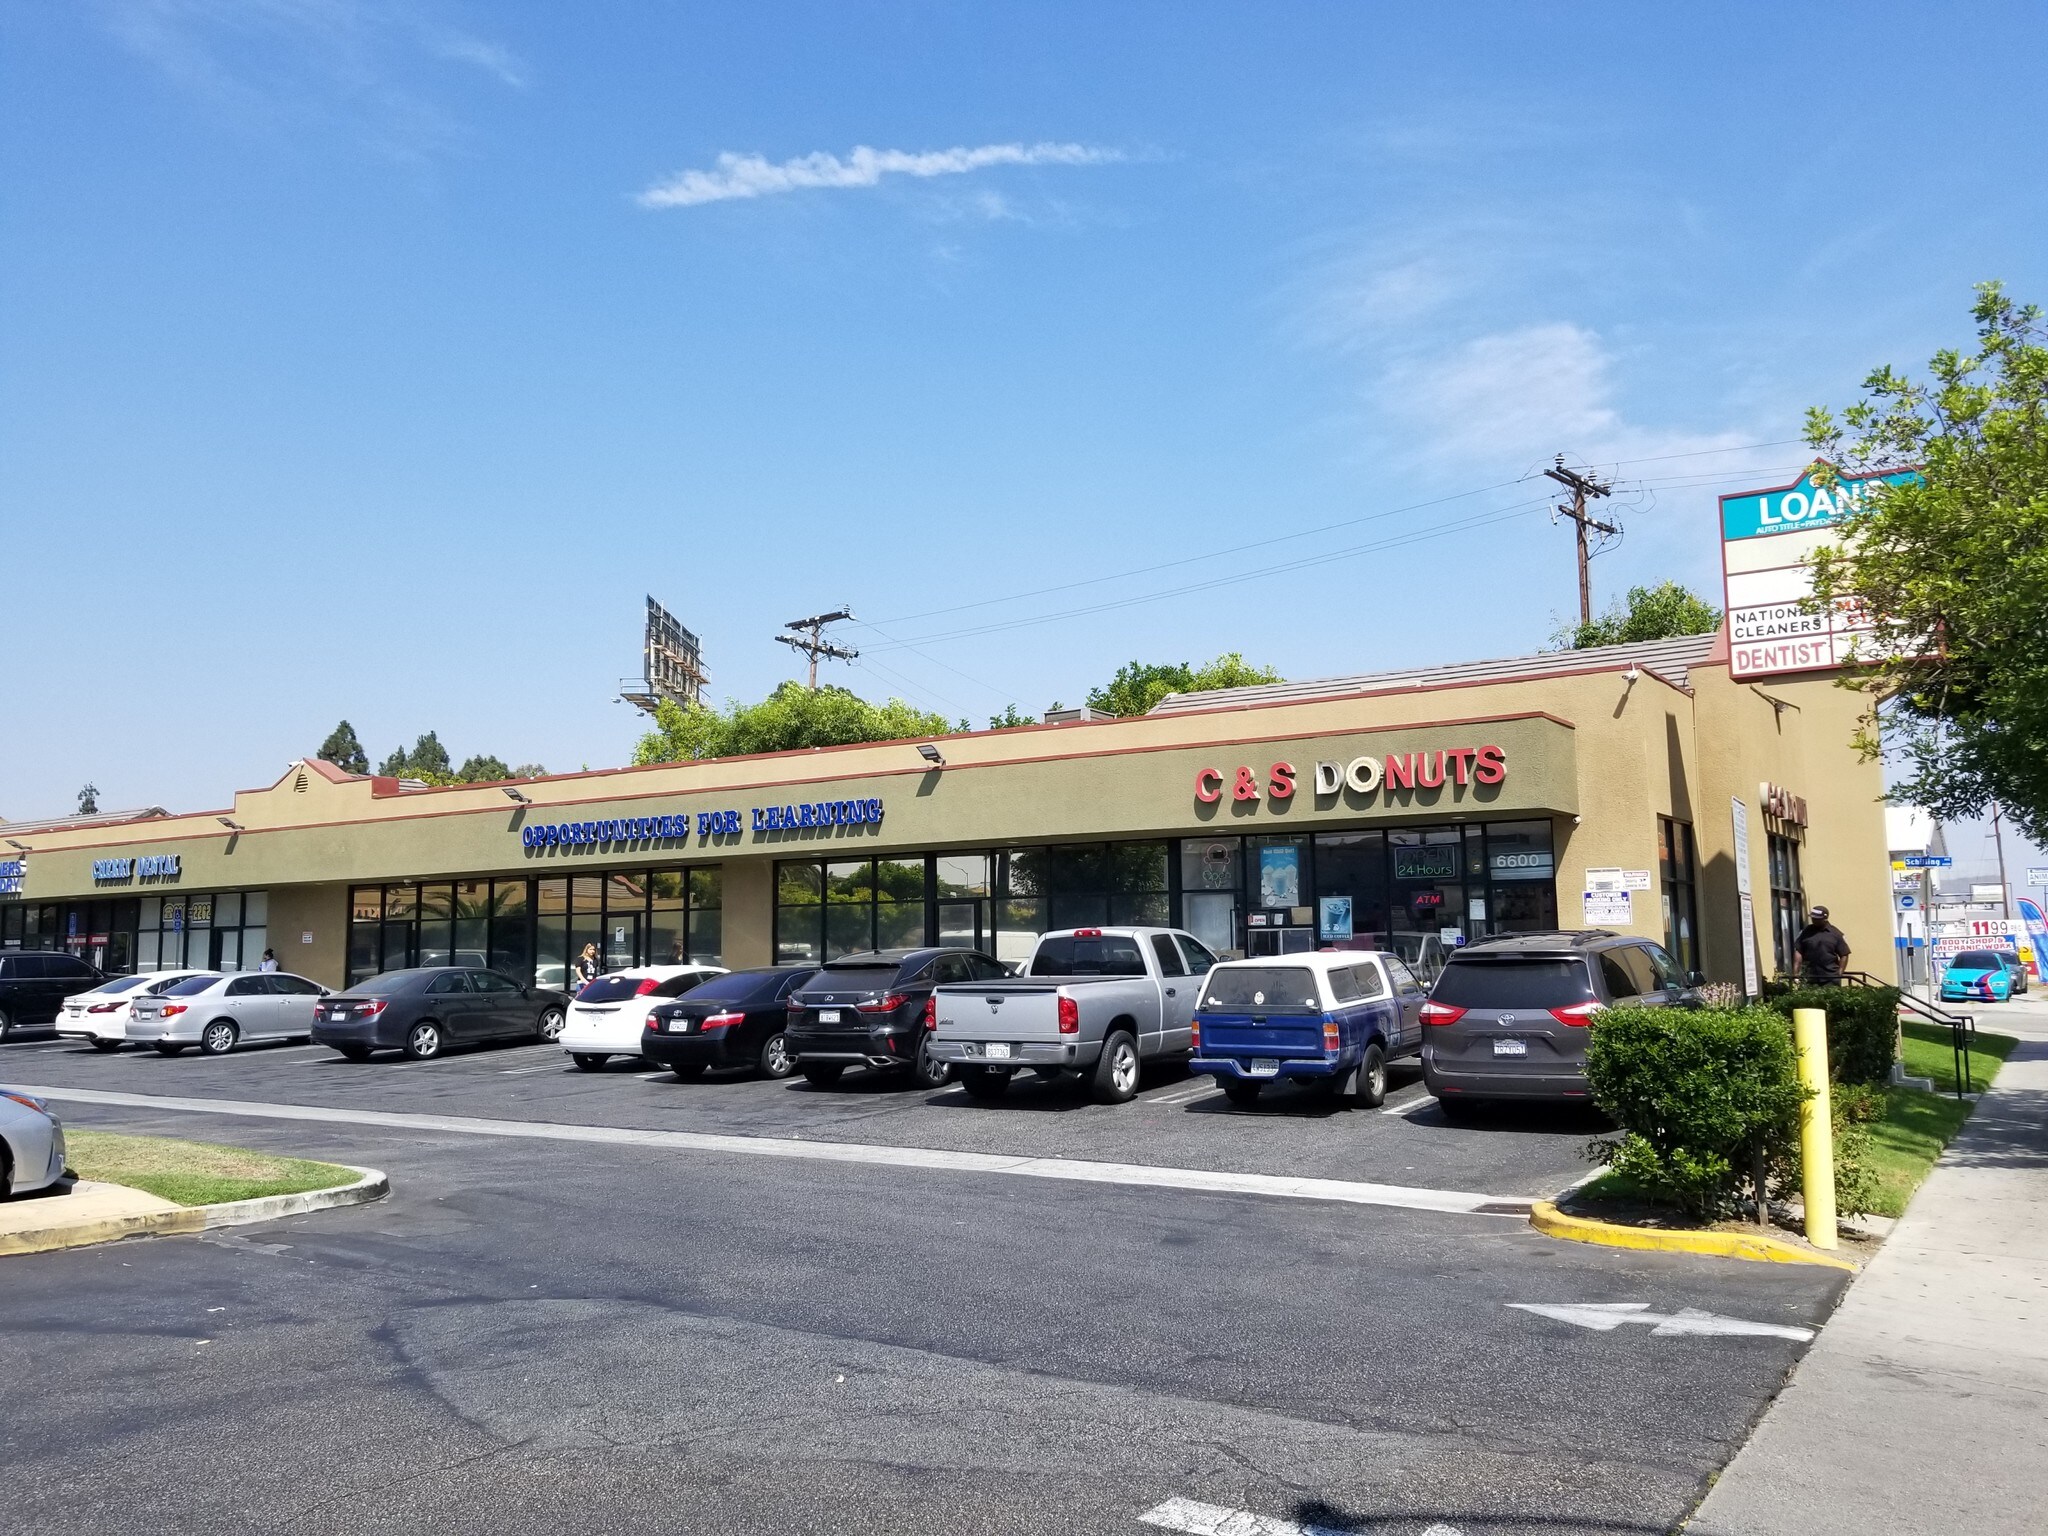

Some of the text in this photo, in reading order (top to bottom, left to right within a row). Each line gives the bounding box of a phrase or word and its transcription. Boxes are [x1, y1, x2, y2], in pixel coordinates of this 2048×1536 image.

[1756, 524, 1778, 534] AUTO
[1780, 521, 1801, 531] TITLE
[1735, 617, 1821, 639] CLEANERS
[1736, 642, 1826, 671] DENTIST
[1195, 745, 1506, 803] C & S DONUTS
[522, 798, 882, 848] OPPORTUNITIES FOR LEARNING
[92, 854, 179, 880] CHERRY DENTAL
[1398, 864, 1452, 876] 24 Hours
[1497, 854, 1539, 868] 6600
[1416, 895, 1441, 904] ATM
